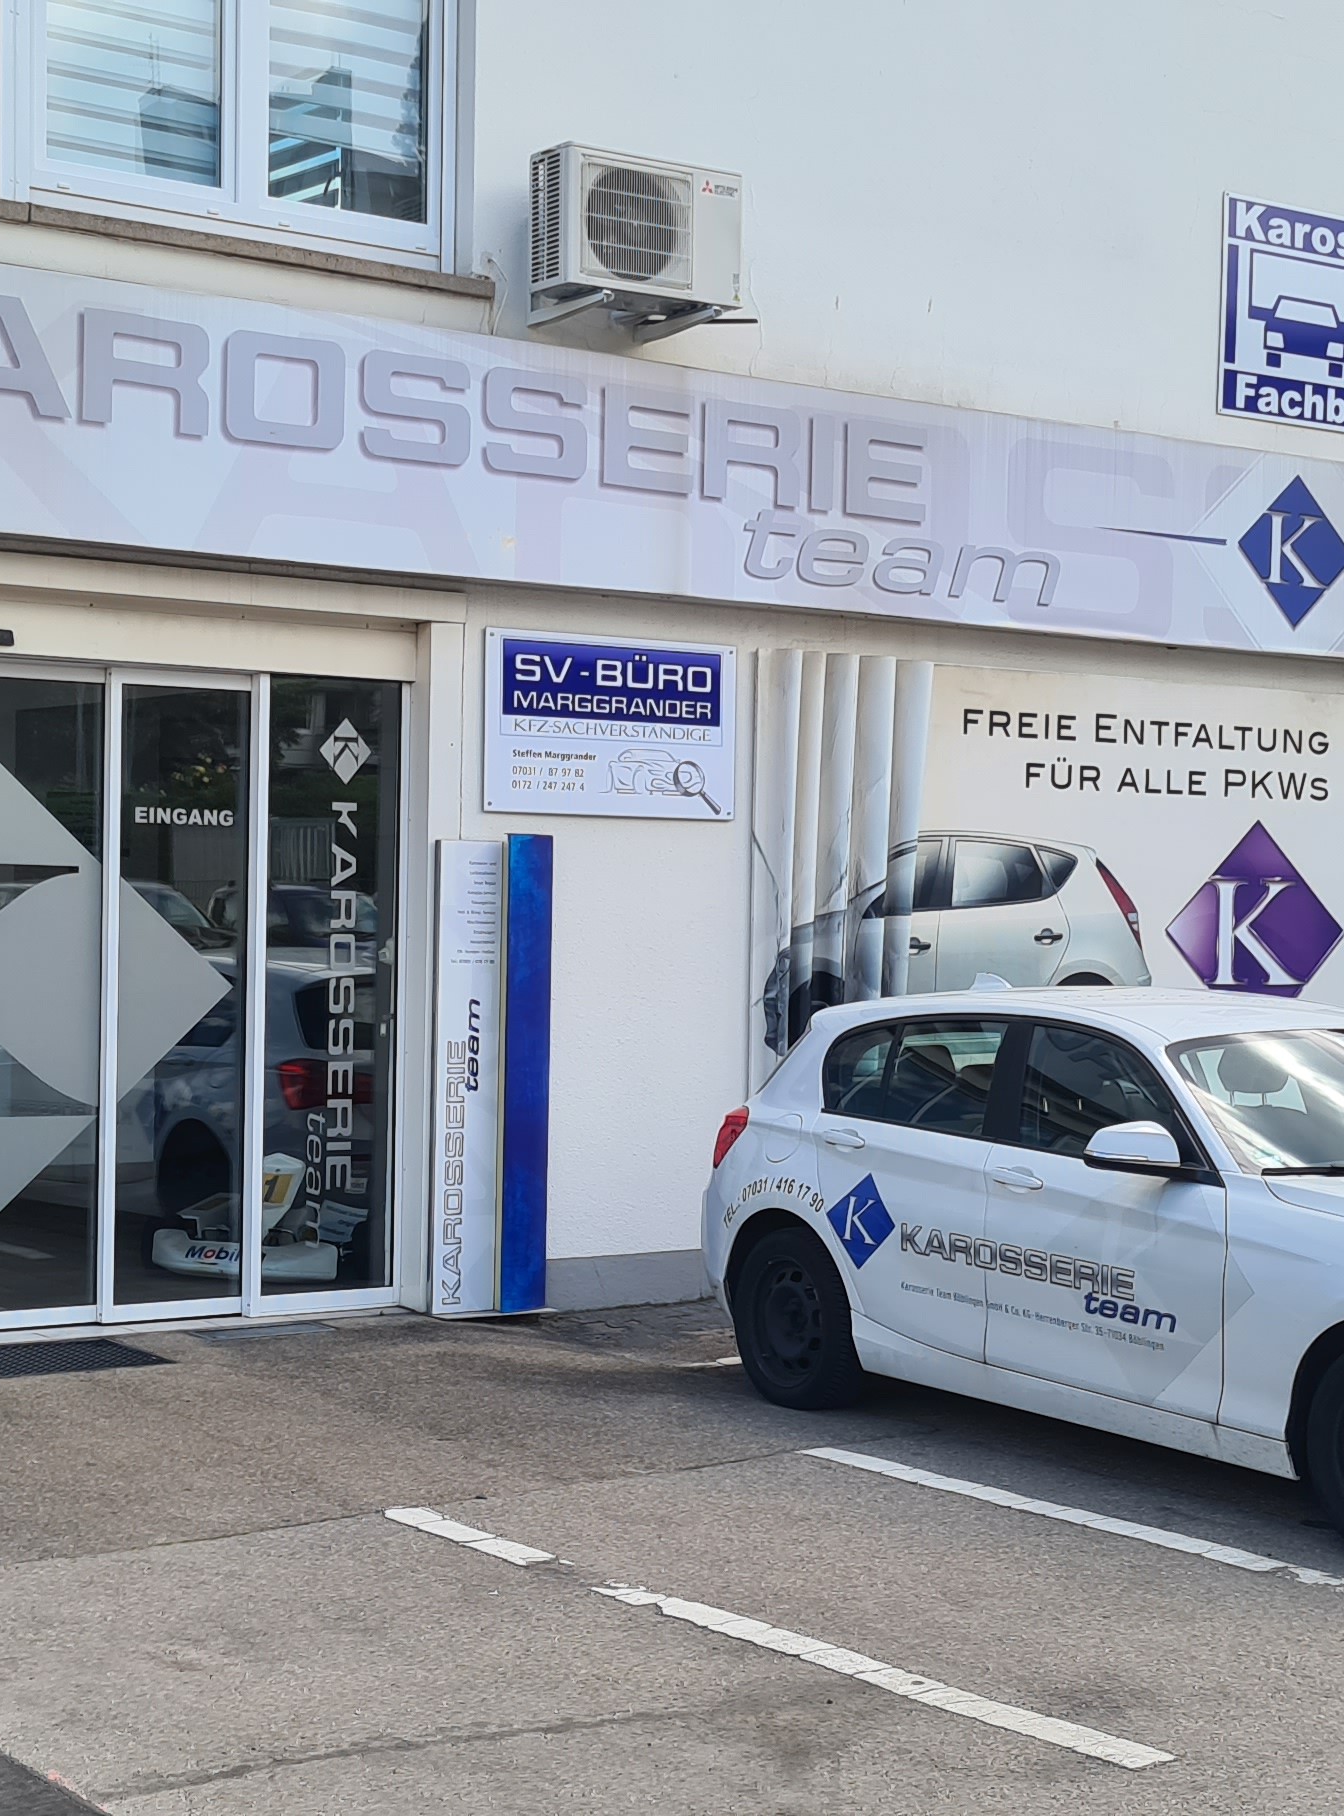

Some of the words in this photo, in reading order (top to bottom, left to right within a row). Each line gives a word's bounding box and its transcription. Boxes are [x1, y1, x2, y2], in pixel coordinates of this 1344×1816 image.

[739, 508, 1063, 611] team
[515, 653, 573, 684] SV
[596, 655, 712, 693] BÜRO
[513, 690, 712, 720] MARGGRANDER
[513, 718, 712, 742] KFZ-SACHVERSTÄNDIGE
[962, 708, 1077, 741] FREIE
[1094, 713, 1329, 755] ENTFALTUNG
[512, 749, 543, 760] Steffen
[544, 750, 597, 762] Marggrander
[512, 766, 537, 777] 07031
[511, 780, 532, 790] 0172
[542, 781, 558, 791] 247
[561, 781, 576, 792] 247
[579, 782, 585, 792] 4
[1025, 757, 1101, 791] FÜR
[1116, 767, 1207, 797] ALLE
[135, 806, 234, 827] EINGANG
[325, 801, 358, 1191] KAROSSERIE
[464, 997, 481, 1094] team
[305, 1111, 325, 1249] team
[441, 1039, 467, 1306] KAROSSERIE
[742, 1177, 768, 1201] 07031
[776, 1177, 795, 1194] 416
[797, 1183, 811, 1200] 17
[809, 1193, 824, 1213] 90
[900, 1221, 1136, 1301] KAROSSERIE
[936, 1287, 952, 1300] Team
[1083, 1291, 1177, 1333] team
